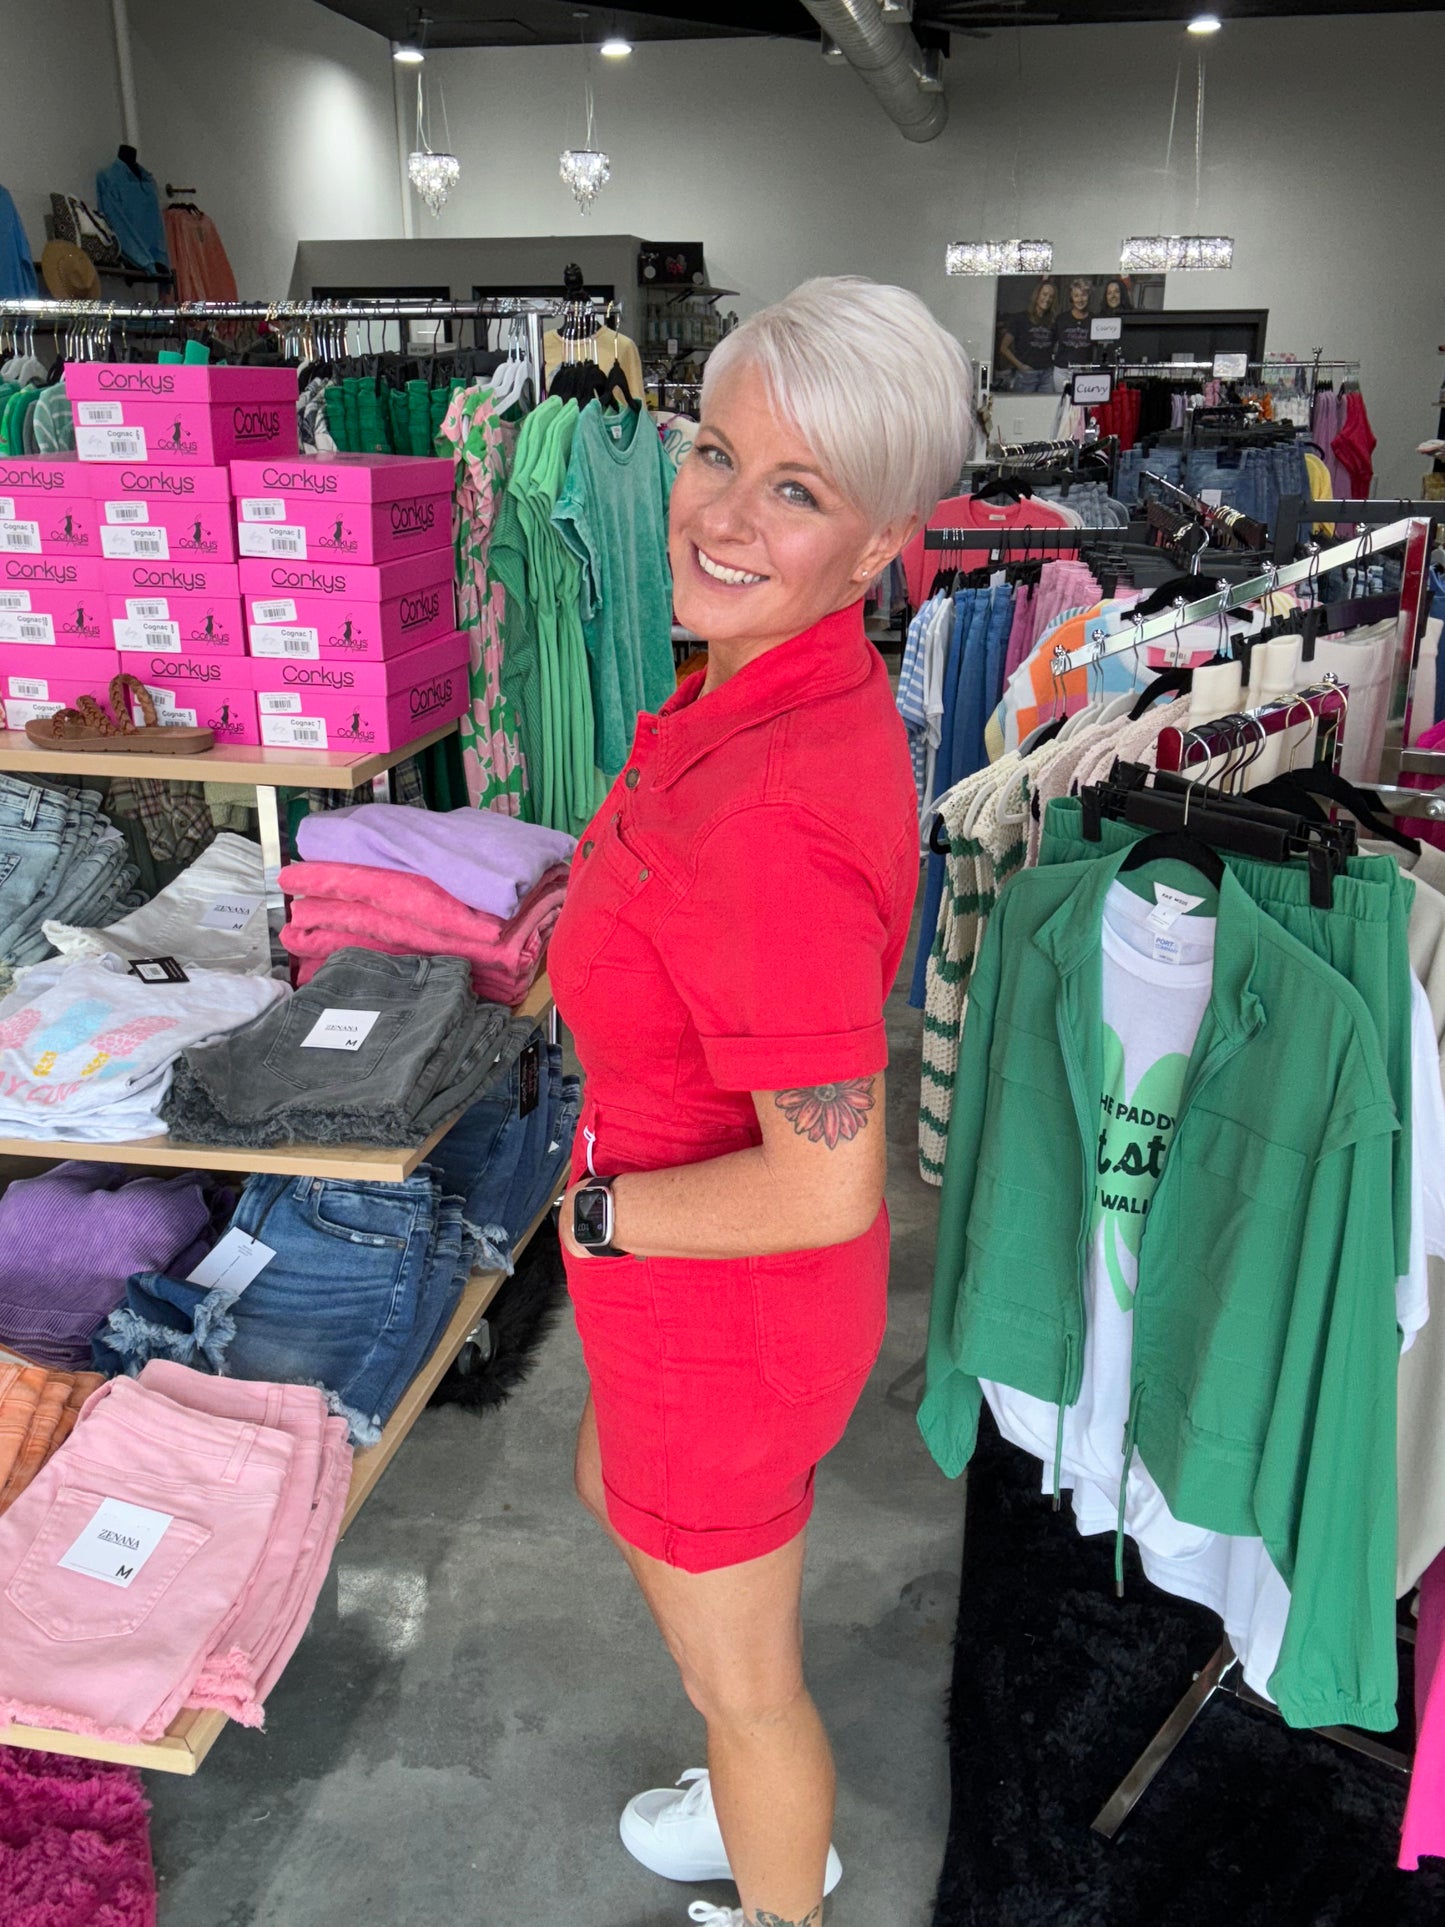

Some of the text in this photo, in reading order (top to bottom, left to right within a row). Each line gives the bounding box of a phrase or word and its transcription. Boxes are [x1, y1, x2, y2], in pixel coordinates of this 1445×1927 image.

[98, 369, 175, 394] Corkys
[1076, 383, 1108, 395] Curvy
[233, 406, 280, 440] Corkys
[107, 430, 133, 438] Cognac
[0, 466, 65, 490] Corkys
[120, 471, 195, 495] Corkys
[262, 468, 338, 494] Corkys
[390, 499, 435, 535] Corkys
[3, 523, 28, 531] Cognac
[130, 529, 156, 538] Cognac
[269, 528, 295, 537] Cognac
[5, 560, 77, 583] Corkys
[133, 567, 207, 591] Corkys
[271, 567, 347, 593] Corkys
[400, 590, 440, 629] Corkys
[17, 615, 42, 624] Cognac
[143, 623, 168, 632] Cognac
[281, 629, 307, 638] Cognac
[151, 658, 221, 682] Corkys
[282, 665, 354, 689] Corkys
[409, 678, 453, 718] Corkys
[33, 703, 56, 712] Cognac
[162, 709, 186, 719] Cognac
[290, 719, 315, 728] Cognac
[214, 905, 249, 915] ZENANA
[1156, 937, 1174, 947] PORT
[98, 1528, 140, 1549] ZENANA
[115, 1565, 134, 1580] M
